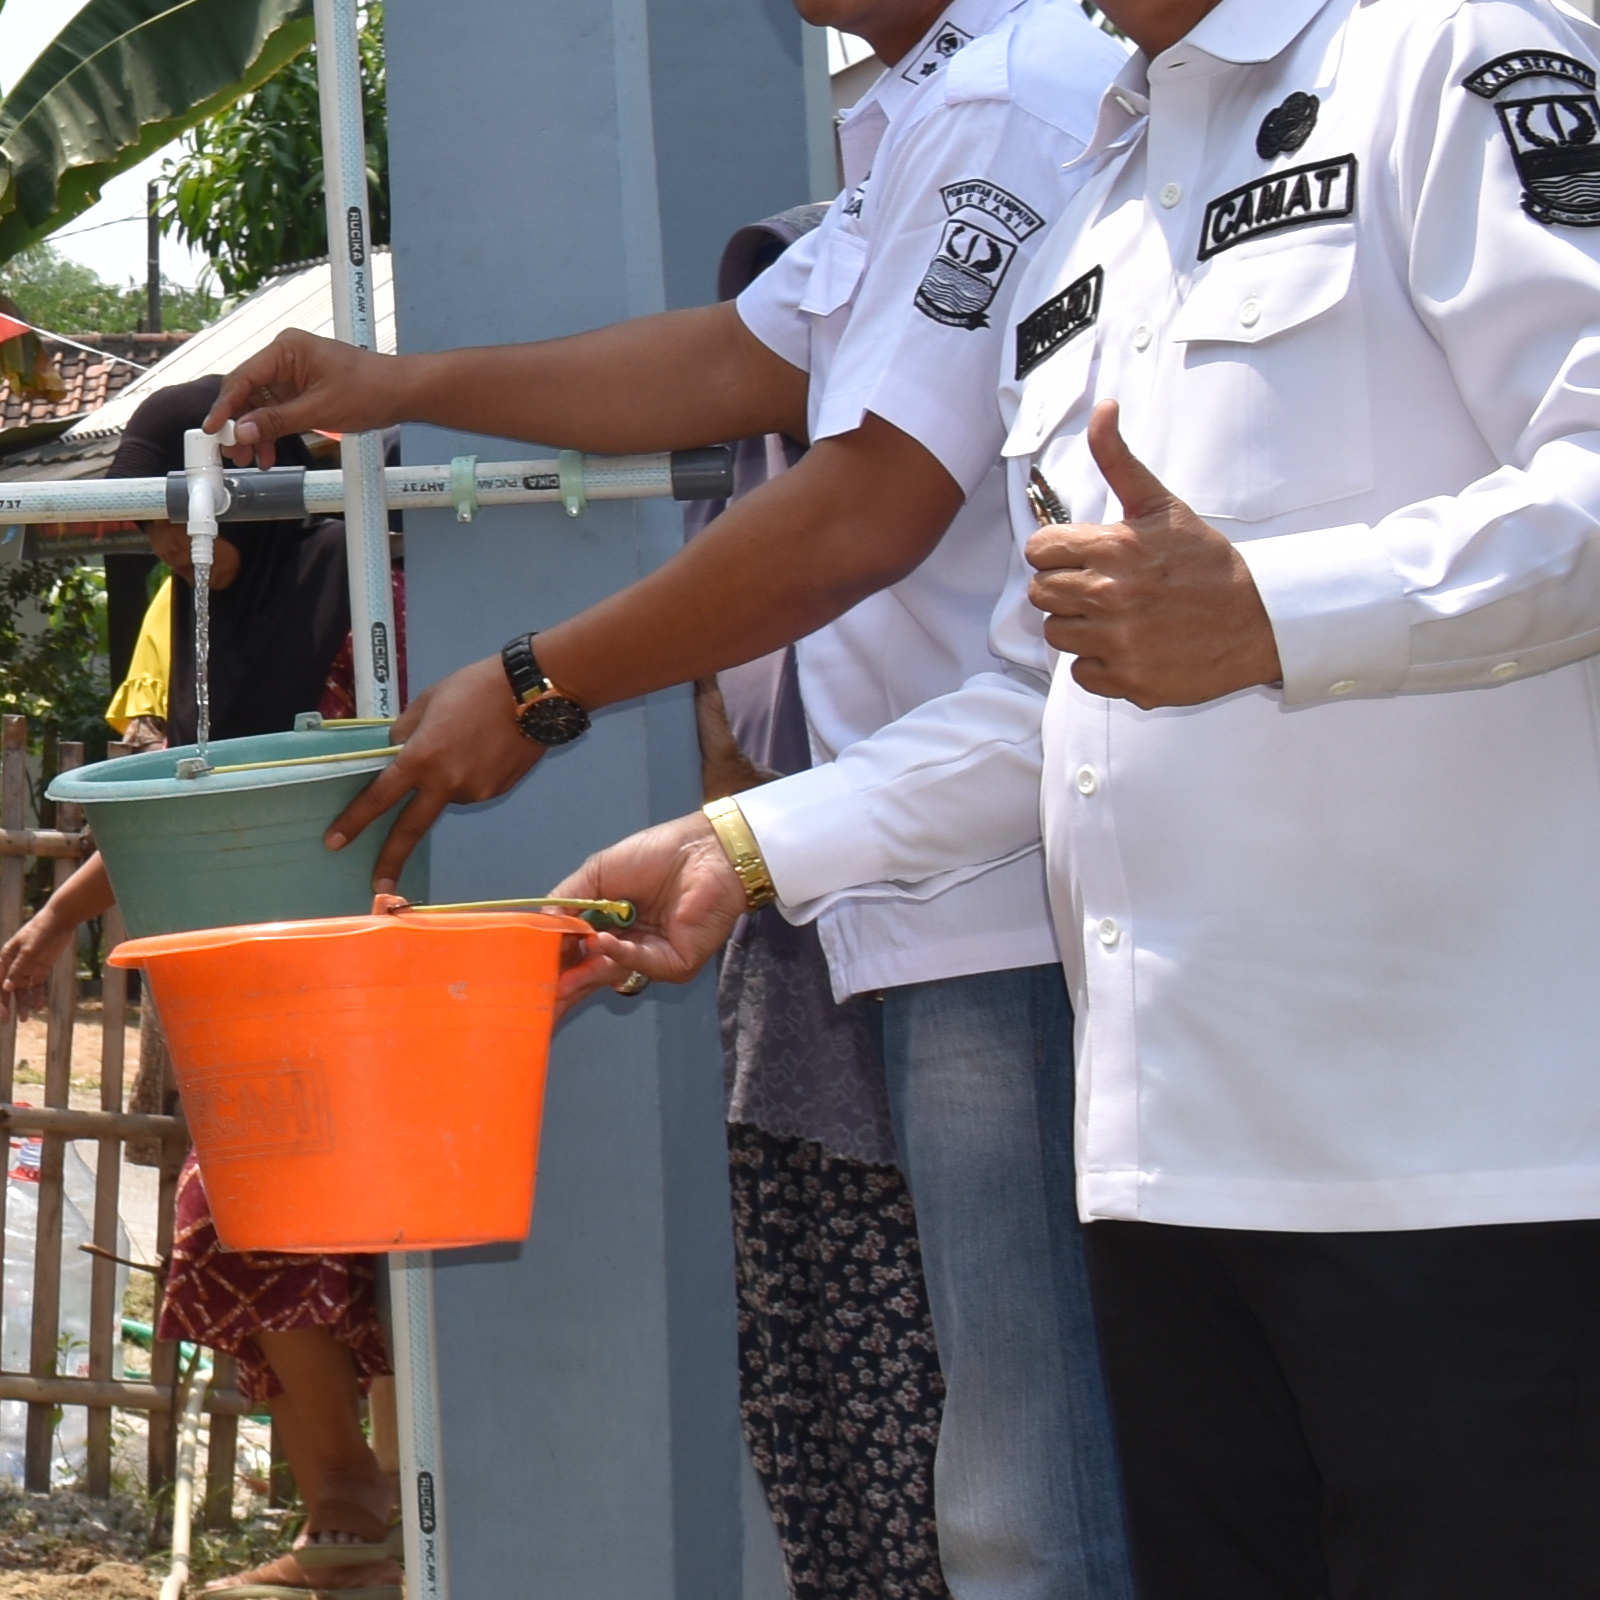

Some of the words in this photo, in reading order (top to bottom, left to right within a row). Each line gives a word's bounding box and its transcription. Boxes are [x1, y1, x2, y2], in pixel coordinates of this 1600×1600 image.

[1210, 165, 1340, 245] CAMAT
[349, 211, 363, 262] RUCIKA
[373, 626, 387, 679] RUCIKA
[419, 1476, 435, 1530] RUCIKA
